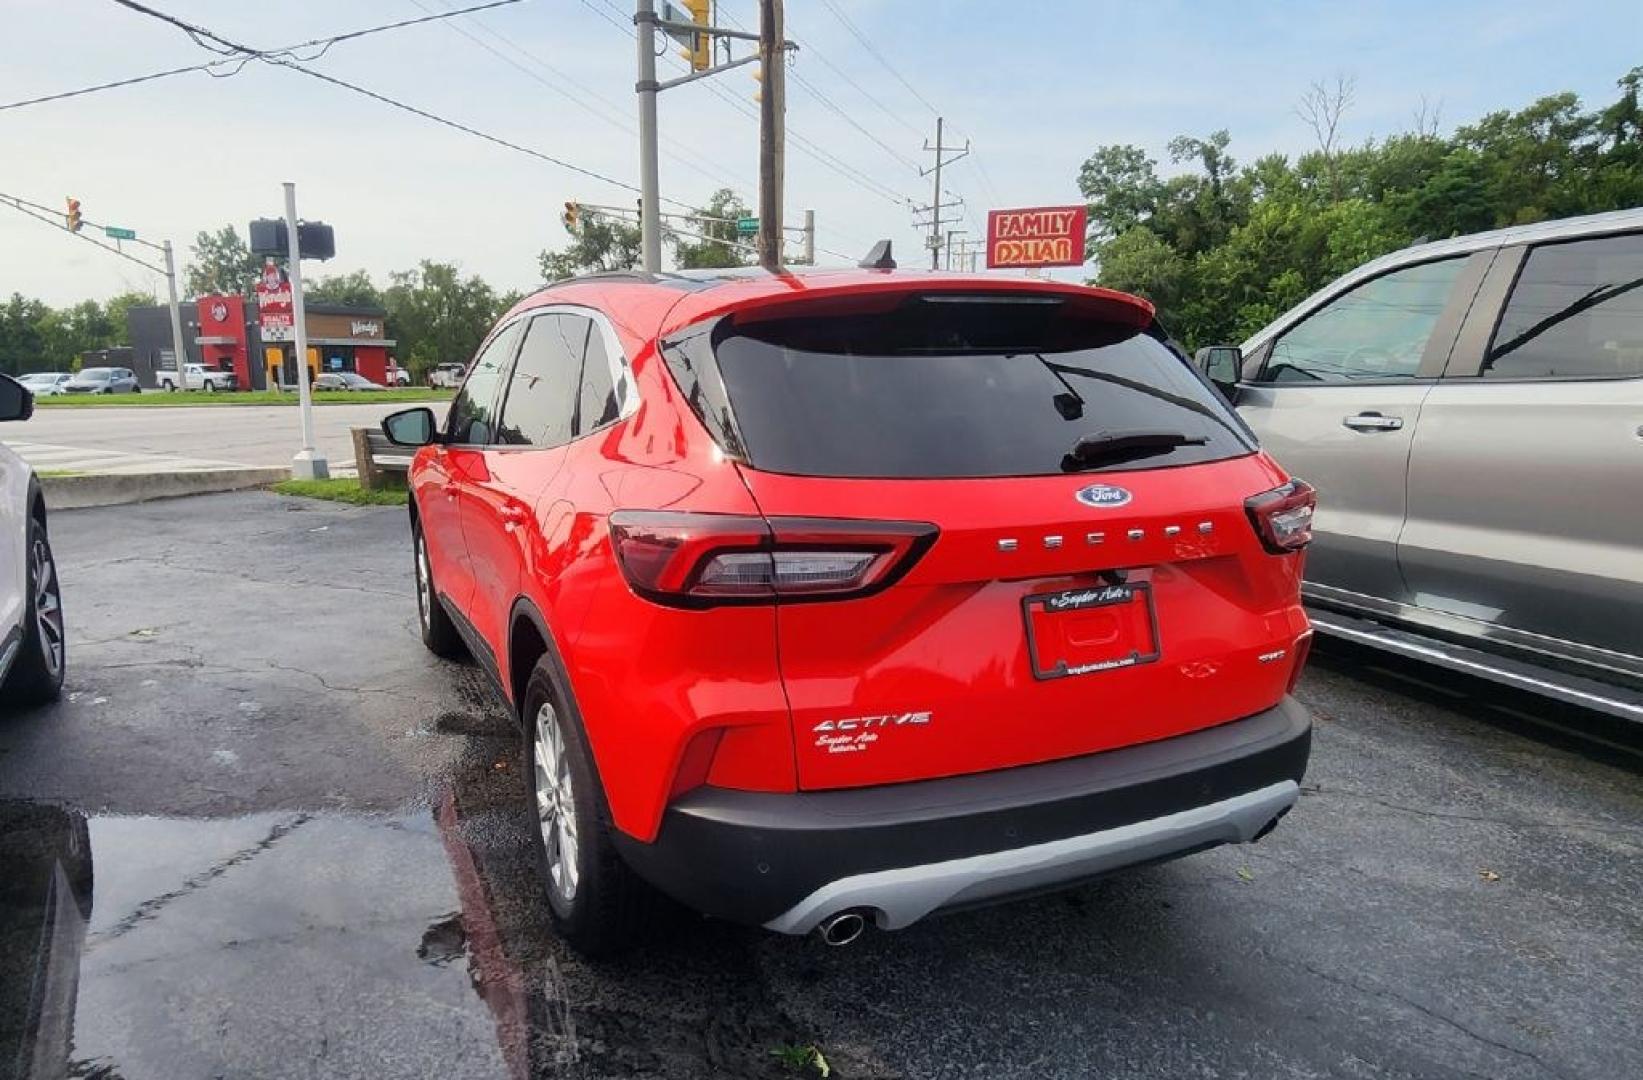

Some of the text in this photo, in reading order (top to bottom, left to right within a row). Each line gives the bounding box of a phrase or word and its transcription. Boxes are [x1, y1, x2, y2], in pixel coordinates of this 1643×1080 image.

[996, 210, 1077, 238] FAMILY
[351, 320, 378, 336] Wendy's
[1091, 487, 1121, 502] Ford
[813, 711, 933, 732] ACTIVE
